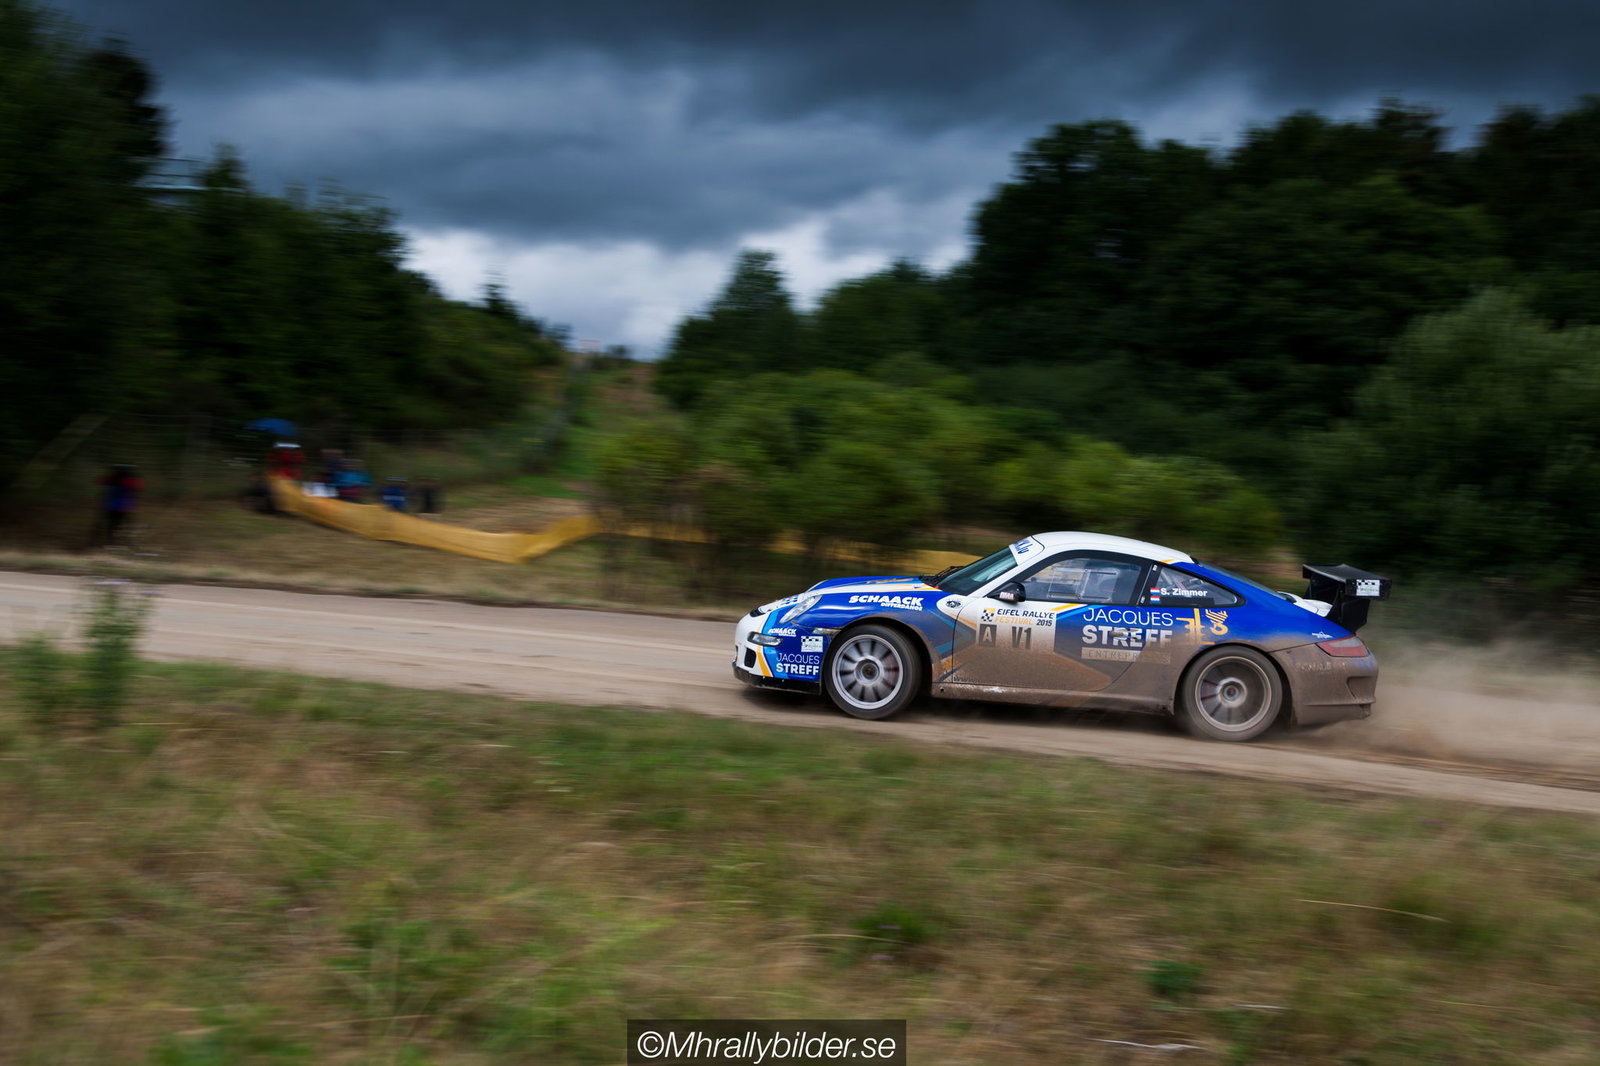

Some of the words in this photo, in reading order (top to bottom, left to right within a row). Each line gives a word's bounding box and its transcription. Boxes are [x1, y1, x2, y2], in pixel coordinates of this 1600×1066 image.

[1160, 588, 1170, 596] S.
[1172, 588, 1208, 597] Zimmer
[848, 595, 924, 607] SCHAACK
[997, 608, 1020, 617] EIFEL
[1022, 610, 1055, 619] RALLYE
[1083, 607, 1174, 626] JACQUES
[994, 616, 1033, 625] FESTIVAL
[1036, 619, 1053, 627] 2015
[982, 626, 993, 642] A
[1082, 624, 1173, 647] STREFF
[776, 653, 820, 665] JACQUES
[776, 663, 819, 676] STREFF
